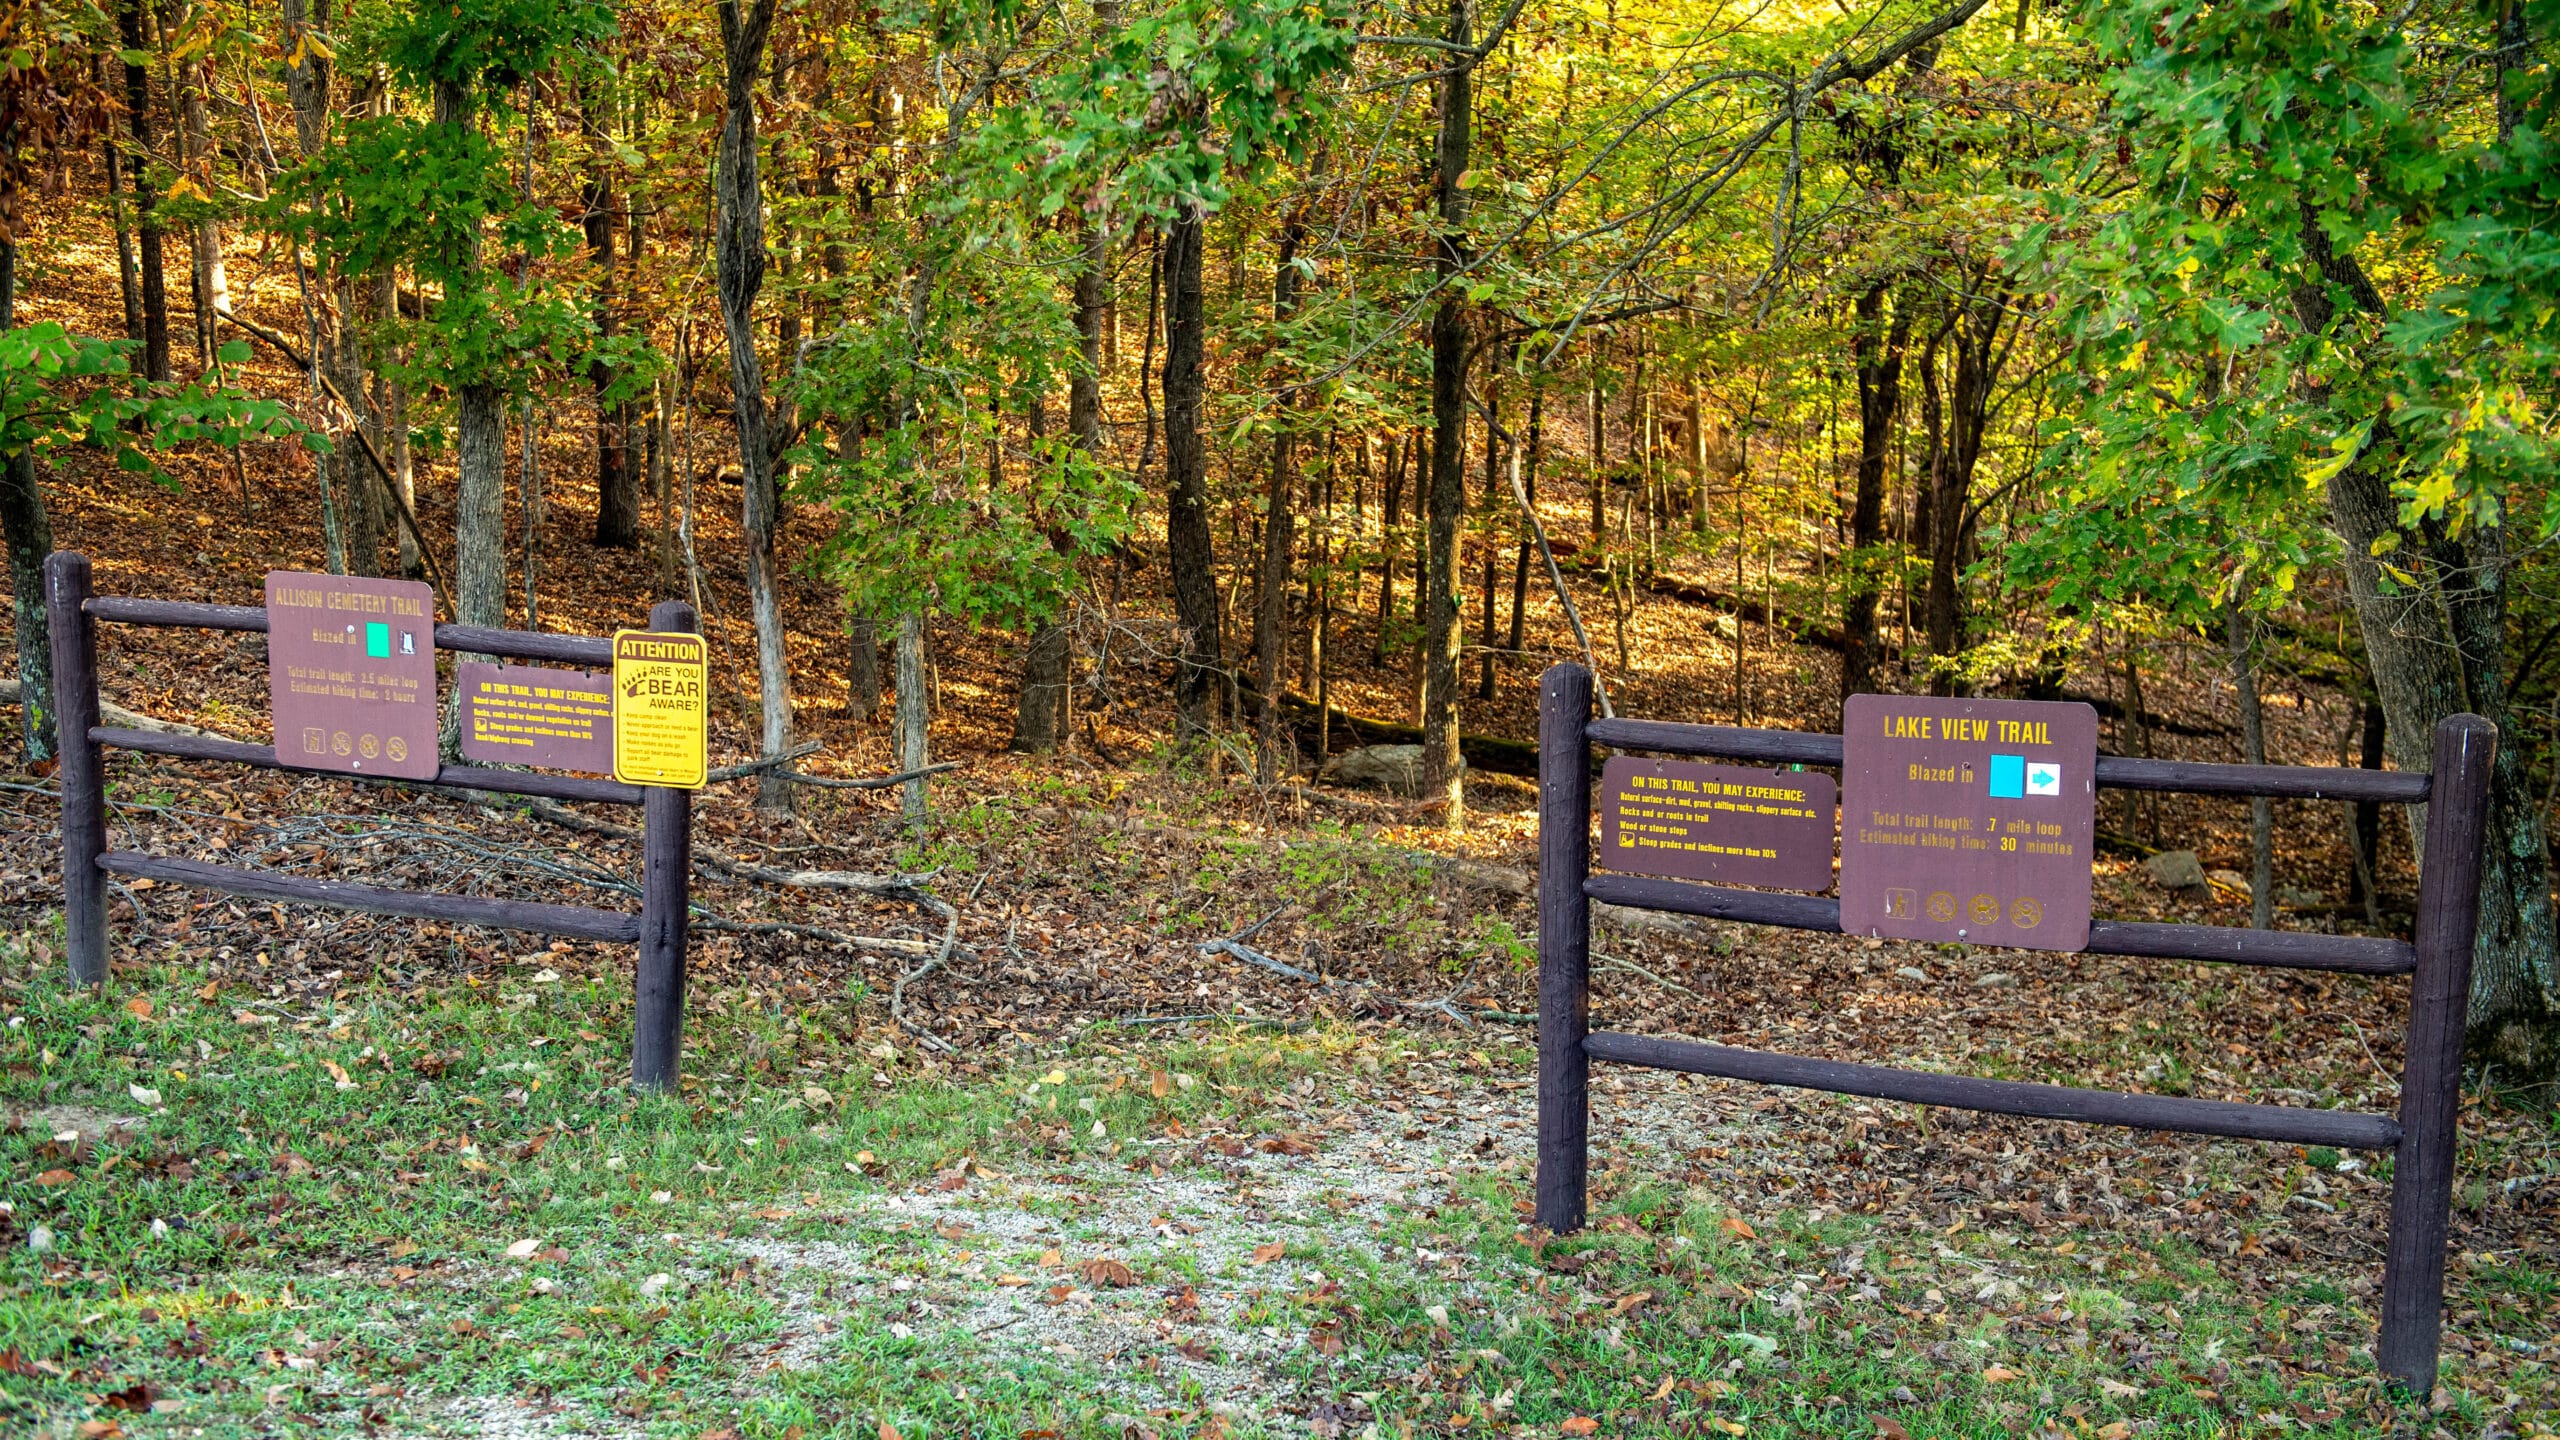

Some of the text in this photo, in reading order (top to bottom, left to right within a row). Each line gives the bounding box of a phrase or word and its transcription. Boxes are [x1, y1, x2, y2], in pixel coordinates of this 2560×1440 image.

[276, 588, 423, 616] ALLISON CEMETERY TRAIL
[312, 628, 356, 645] Blazed in
[620, 640, 699, 660] ATTENTION
[288, 666, 306, 678] Total
[309, 669, 325, 679] trail
[328, 670, 355, 683] length:
[361, 673, 374, 684] 2.5
[402, 676, 418, 689] loop
[649, 666, 698, 678] ARE YOU
[290, 680, 416, 703] Estimated hiking time: 2 hours
[481, 682, 610, 704] ON THIS TRAIL, YOU MAY EXPERIENCE:
[649, 679, 699, 697] BEAR
[649, 698, 698, 711] AWARE?
[1884, 715, 2052, 745] LAKE VIEW TRAIL
[1909, 764, 1973, 783] Blazed in
[1632, 776, 1806, 802] ON THIS TRAIL, YOU MAY EXPERIENCE:
[1620, 792, 1640, 801] Natural
[1679, 798, 1692, 807] mud,
[1694, 799, 1712, 809] gravel,
[1714, 800, 1735, 812] shifting
[1737, 803, 1754, 812] rocks,
[1756, 805, 1778, 816] slippery
[1781, 807, 1802, 816] surface
[1805, 810, 1817, 818] etc.
[1620, 807, 1640, 816] Rocks
[1642, 809, 1654, 818] and
[1686, 813, 1693, 821] in
[1695, 814, 1709, 823] trail
[1620, 821, 1637, 830] Wood
[1649, 825, 1667, 833] stone
[1669, 826, 1687, 836] steps
[1872, 811, 2062, 837] Total trail length: .7 mile loop
[1639, 837, 1776, 858] Steep grades and inclines more than 10%
[1860, 829, 2073, 855] Estimated hiking time: 30 minutes
